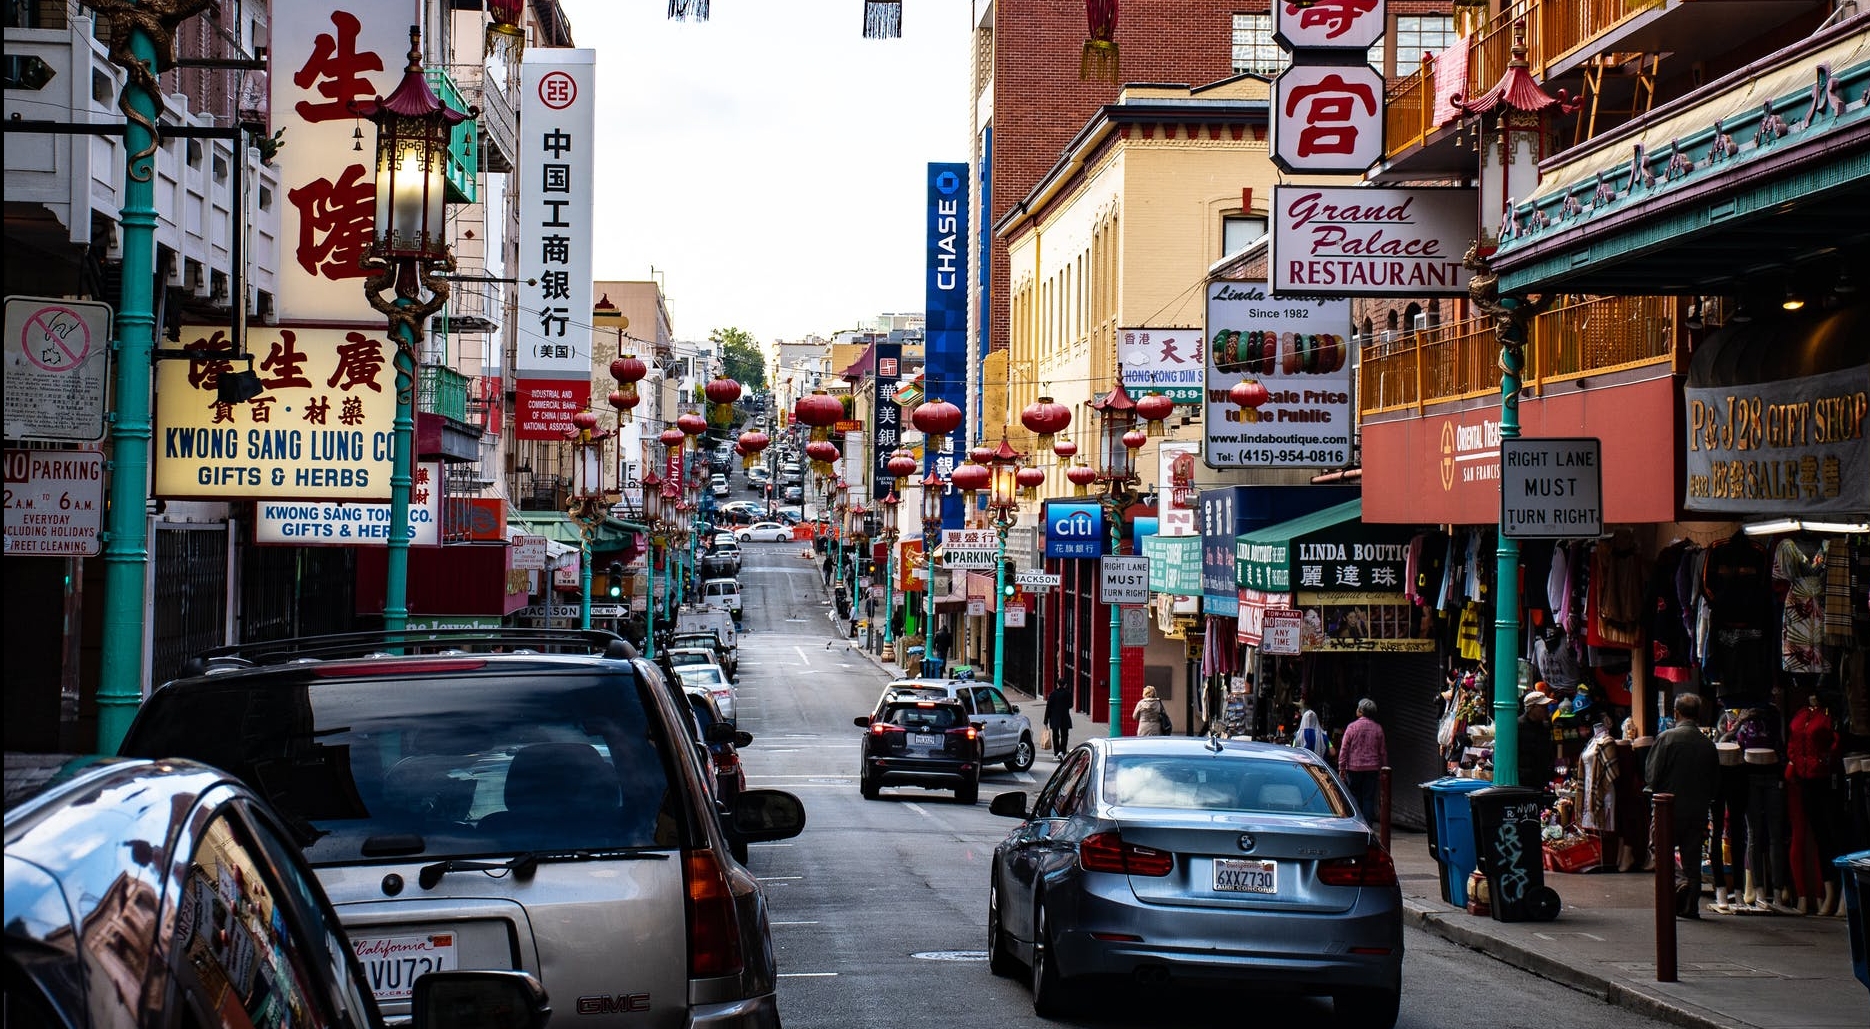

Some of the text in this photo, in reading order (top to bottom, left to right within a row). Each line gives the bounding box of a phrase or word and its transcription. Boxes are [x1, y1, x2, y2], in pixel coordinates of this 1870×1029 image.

[1288, 193, 1413, 230] Grand
[540, 128, 571, 338] 中国工商银行
[1310, 225, 1440, 255] Palace
[937, 199, 957, 290] CHASE
[1289, 260, 1463, 286] RESTAURANT
[1212, 285, 1266, 301] Linda
[1249, 309, 1309, 319] Since 1982
[1125, 333, 1150, 345] 香港
[1125, 370, 1150, 382] HONG
[1152, 370, 1177, 382] KONG
[1180, 370, 1196, 382] DIM
[531, 390, 573, 399] INDUSTRIAL AND
[1303, 390, 1348, 404] Price
[528, 400, 577, 410] COMMERCIAL BANK
[532, 411, 540, 420] OF
[541, 411, 557, 420] CHINA
[1277, 409, 1332, 423] Public
[1766, 402, 1810, 448] GIFT
[1815, 391, 1867, 443] SHOP
[523, 421, 547, 431] NATIONAL
[165, 428, 238, 458] KWONG
[248, 429, 301, 459] SANG
[311, 430, 363, 461] LUNG
[1210, 434, 1347, 445] www.lindaboutique.com
[1217, 450, 1344, 464] Tel: (415)-954-0816
[1507, 451, 1595, 466] RIGHT LANE
[4, 453, 99, 480] NO PARKING
[198, 466, 369, 487] GIFTS & HERBS
[1463, 469, 1472, 483] SAN
[1747, 460, 1799, 499] SALE
[1525, 478, 1577, 497] MUST
[4, 490, 95, 511] 2 A.M. TO 6 A.M.
[23, 514, 70, 525] EVERYDAY
[265, 506, 319, 522] KWONG
[323, 508, 362, 523] SANG
[410, 511, 433, 523] CO.
[1507, 509, 1598, 524] TURN RIGHT
[51, 526, 95, 538] HOLIDAYS
[281, 524, 417, 539] GIFTS & HERS
[1055, 515, 1092, 536] citi
[40, 541, 87, 552] CLEANING
[513, 536, 523, 546] NO
[953, 551, 999, 564] PARKING
[1299, 543, 1347, 561] LINDA
[1104, 562, 1147, 571] RIGHT LANE
[1014, 575, 1058, 584] JACKSON
[1107, 575, 1143, 585] MUST
[1300, 564, 1398, 588] 麗達珠
[1103, 588, 1147, 598] TURN RIGHT
[520, 607, 577, 617] JACSON
[1265, 617, 1300, 628] NO STOPPING
[1217, 870, 1273, 887] 6XXZ730
[356, 939, 434, 958] California
[577, 993, 651, 1014] GMC
